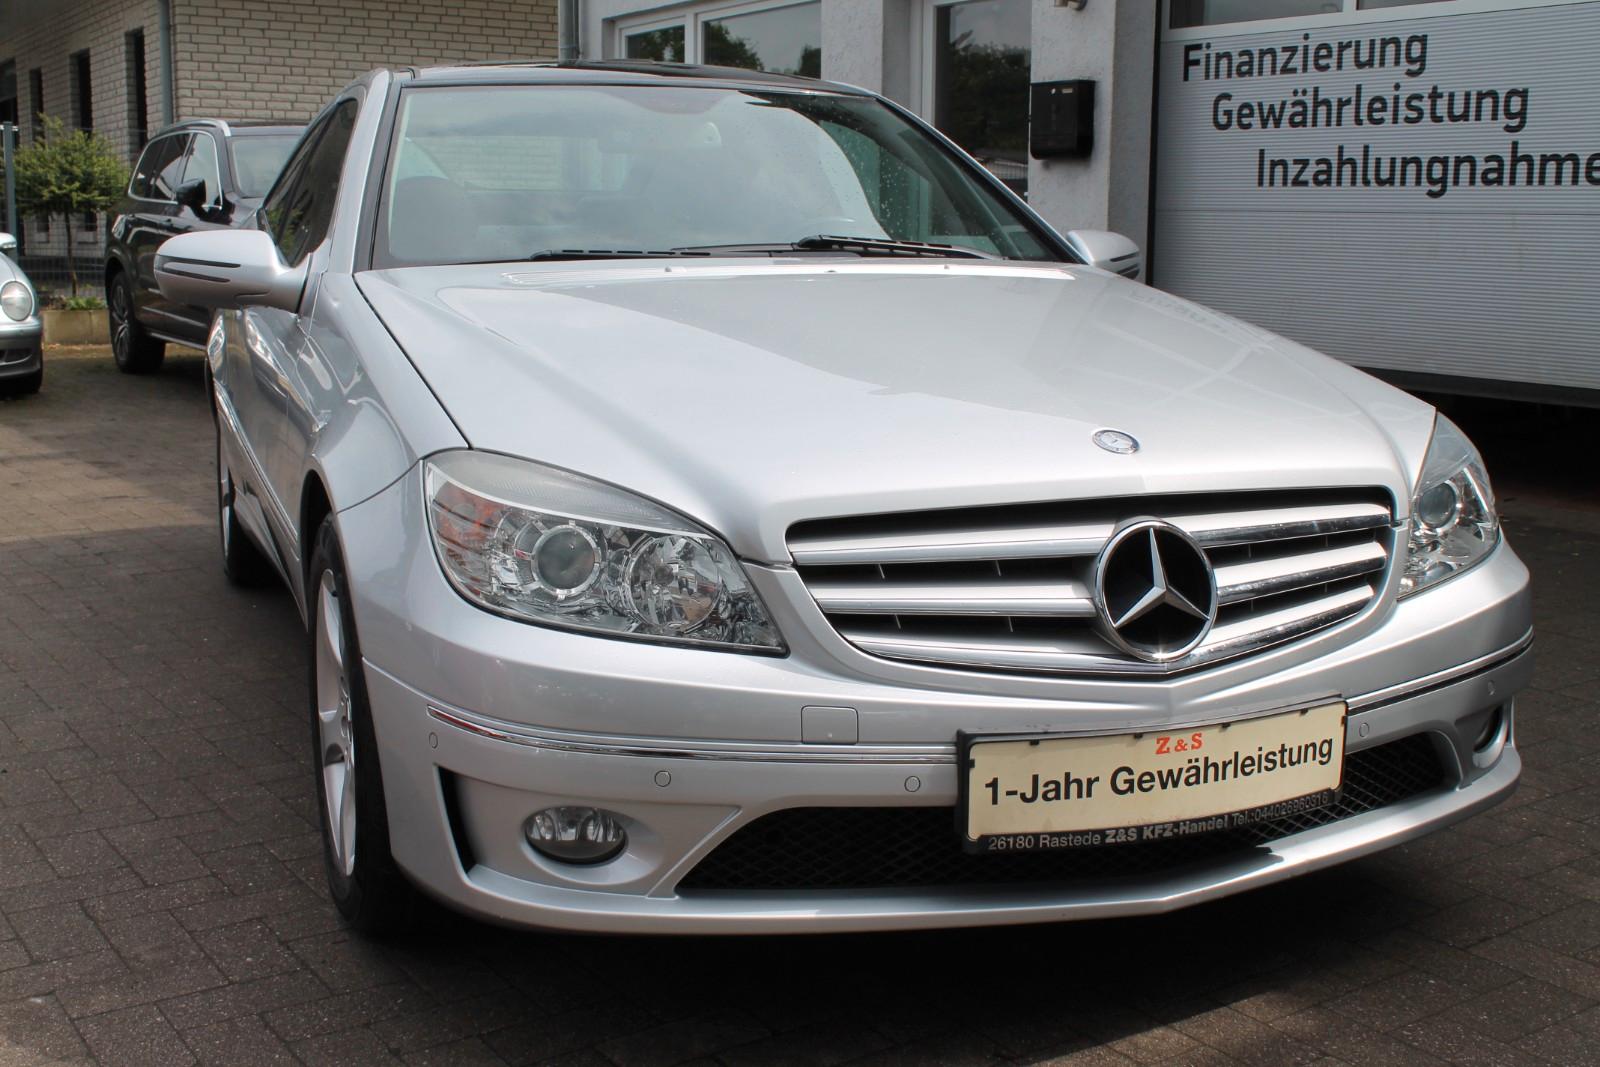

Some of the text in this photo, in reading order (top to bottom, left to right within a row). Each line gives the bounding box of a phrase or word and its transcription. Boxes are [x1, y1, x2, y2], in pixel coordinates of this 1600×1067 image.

[1183, 33, 1428, 82] Finanzierung
[1212, 83, 1529, 133] Gewährleistung
[984, 738, 1333, 805] 1-Jahr Gewährleistung
[988, 835, 1034, 850] 26180
[1040, 832, 1101, 848] Rastede
[1142, 815, 1229, 840] KFZ-Handel
